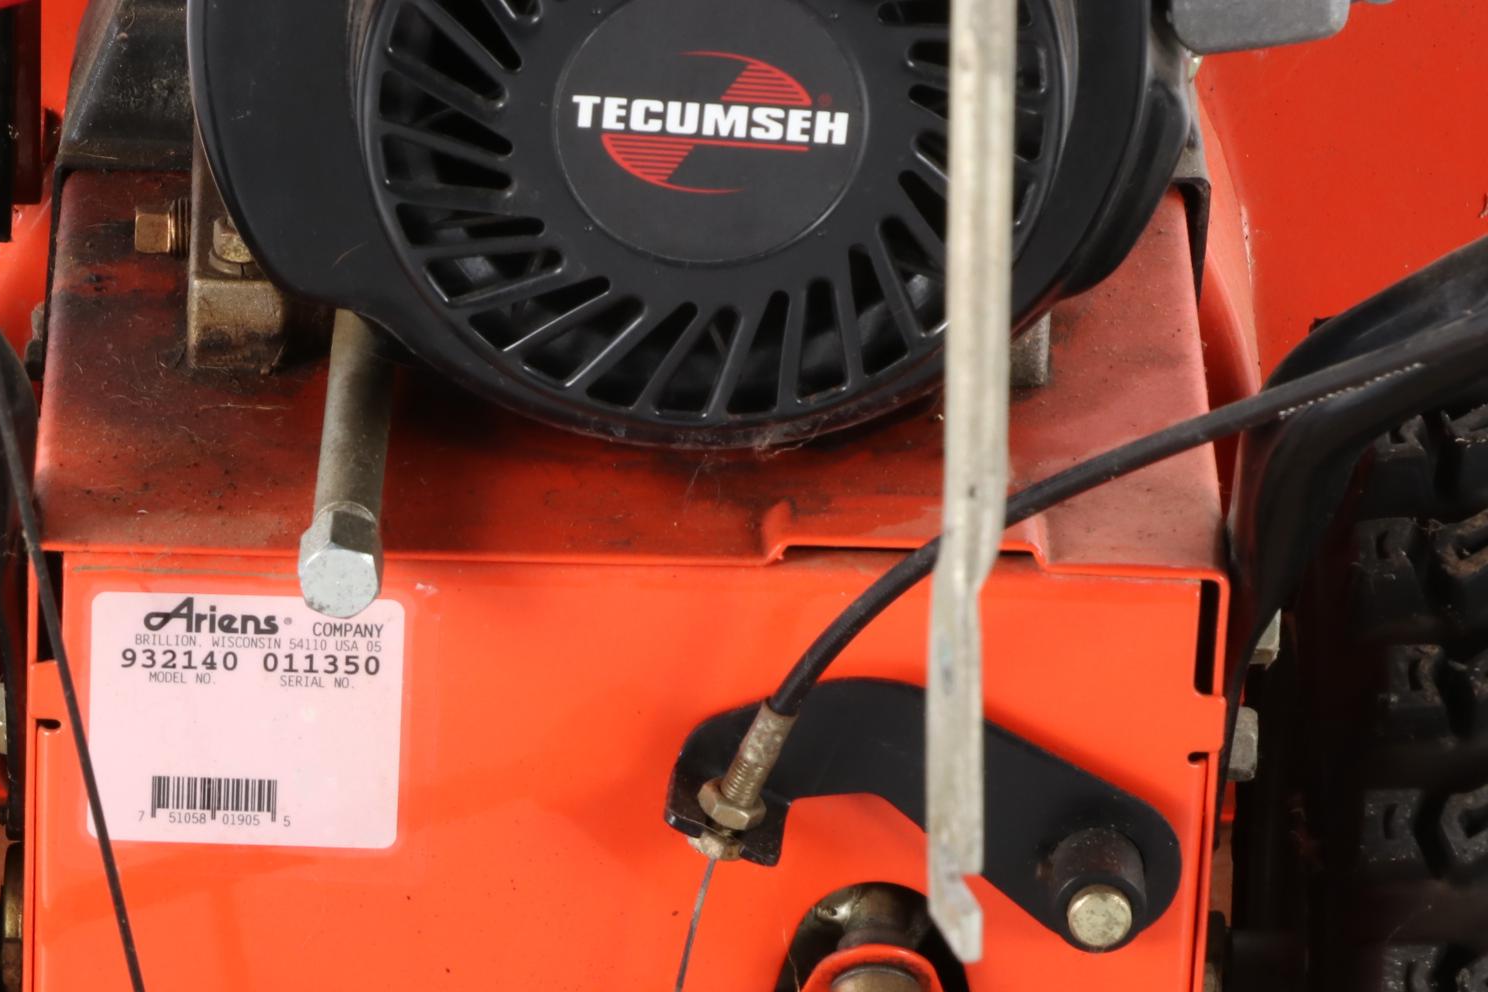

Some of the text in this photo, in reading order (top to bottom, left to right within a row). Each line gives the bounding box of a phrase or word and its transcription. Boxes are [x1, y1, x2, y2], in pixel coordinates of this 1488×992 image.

[572, 94, 850, 146] TECUMSEH
[312, 622, 384, 638] COMPANY
[212, 637, 281, 650] WISCONSIN
[289, 638, 327, 651] 54110
[335, 640, 358, 652] USA
[366, 640, 382, 653] 05
[121, 648, 381, 675] 932140 011350
[149, 671, 354, 689] MODEL NO. SERIAL NO.
[138, 810, 291, 827] 7 51058 01905 5
